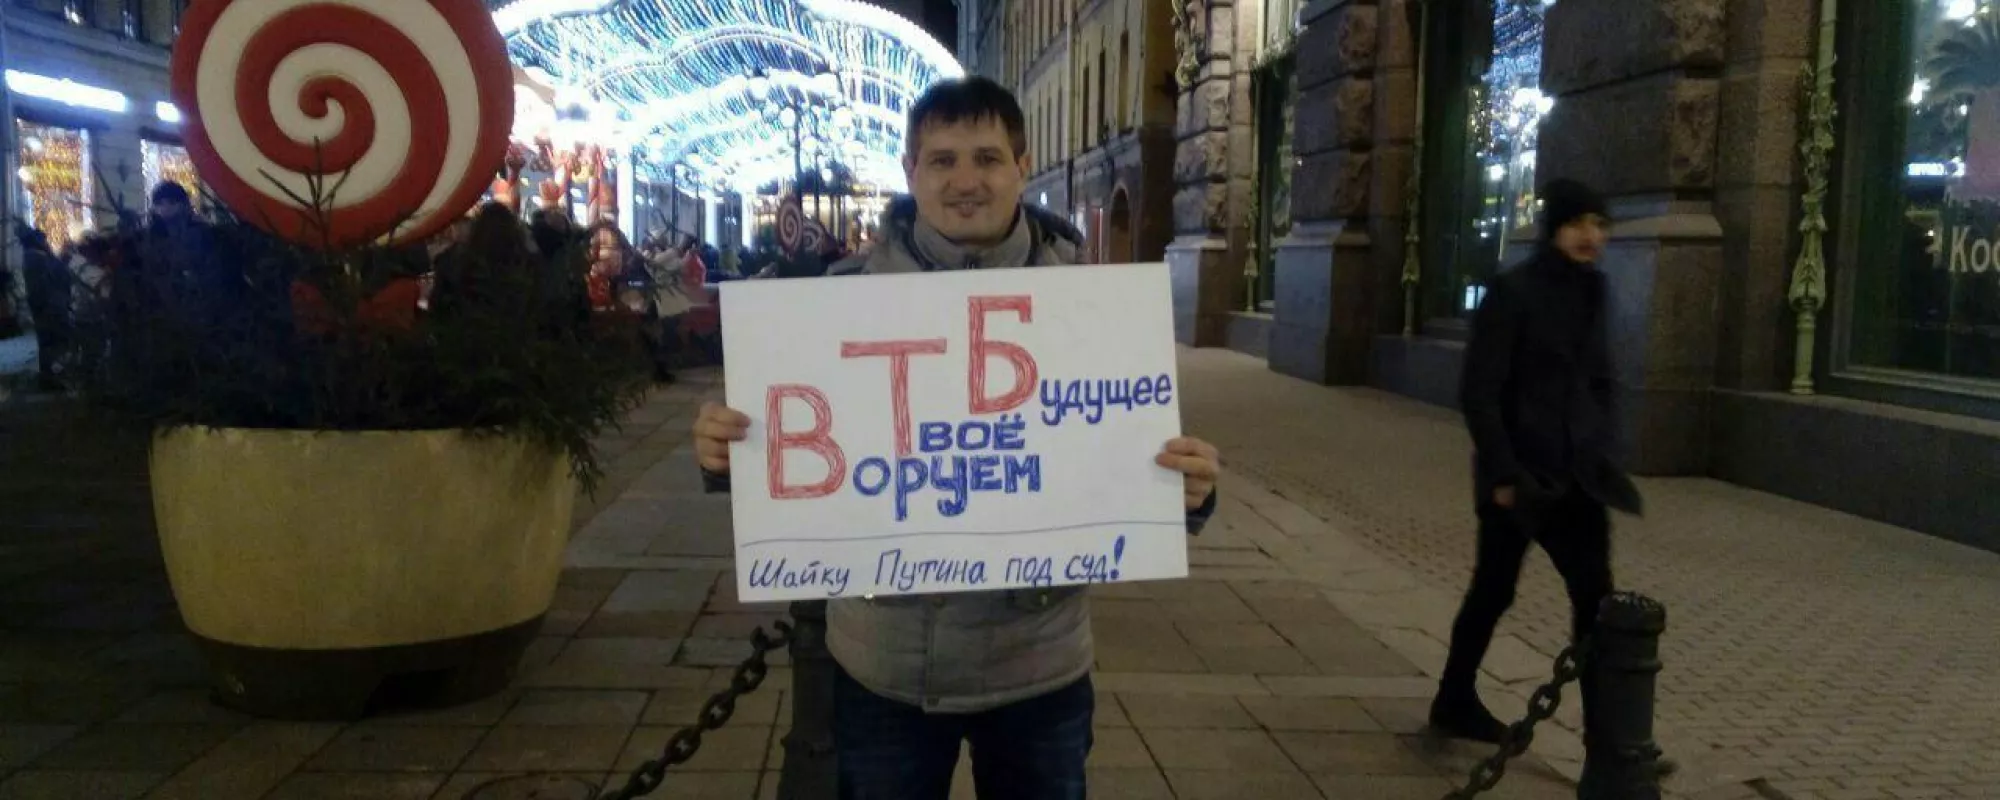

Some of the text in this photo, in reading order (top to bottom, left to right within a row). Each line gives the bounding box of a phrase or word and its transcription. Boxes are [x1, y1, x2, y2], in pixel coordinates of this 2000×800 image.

[967, 295, 1172, 426] Будущее
[749, 535, 1126, 590] Шайку Путина под суд!
